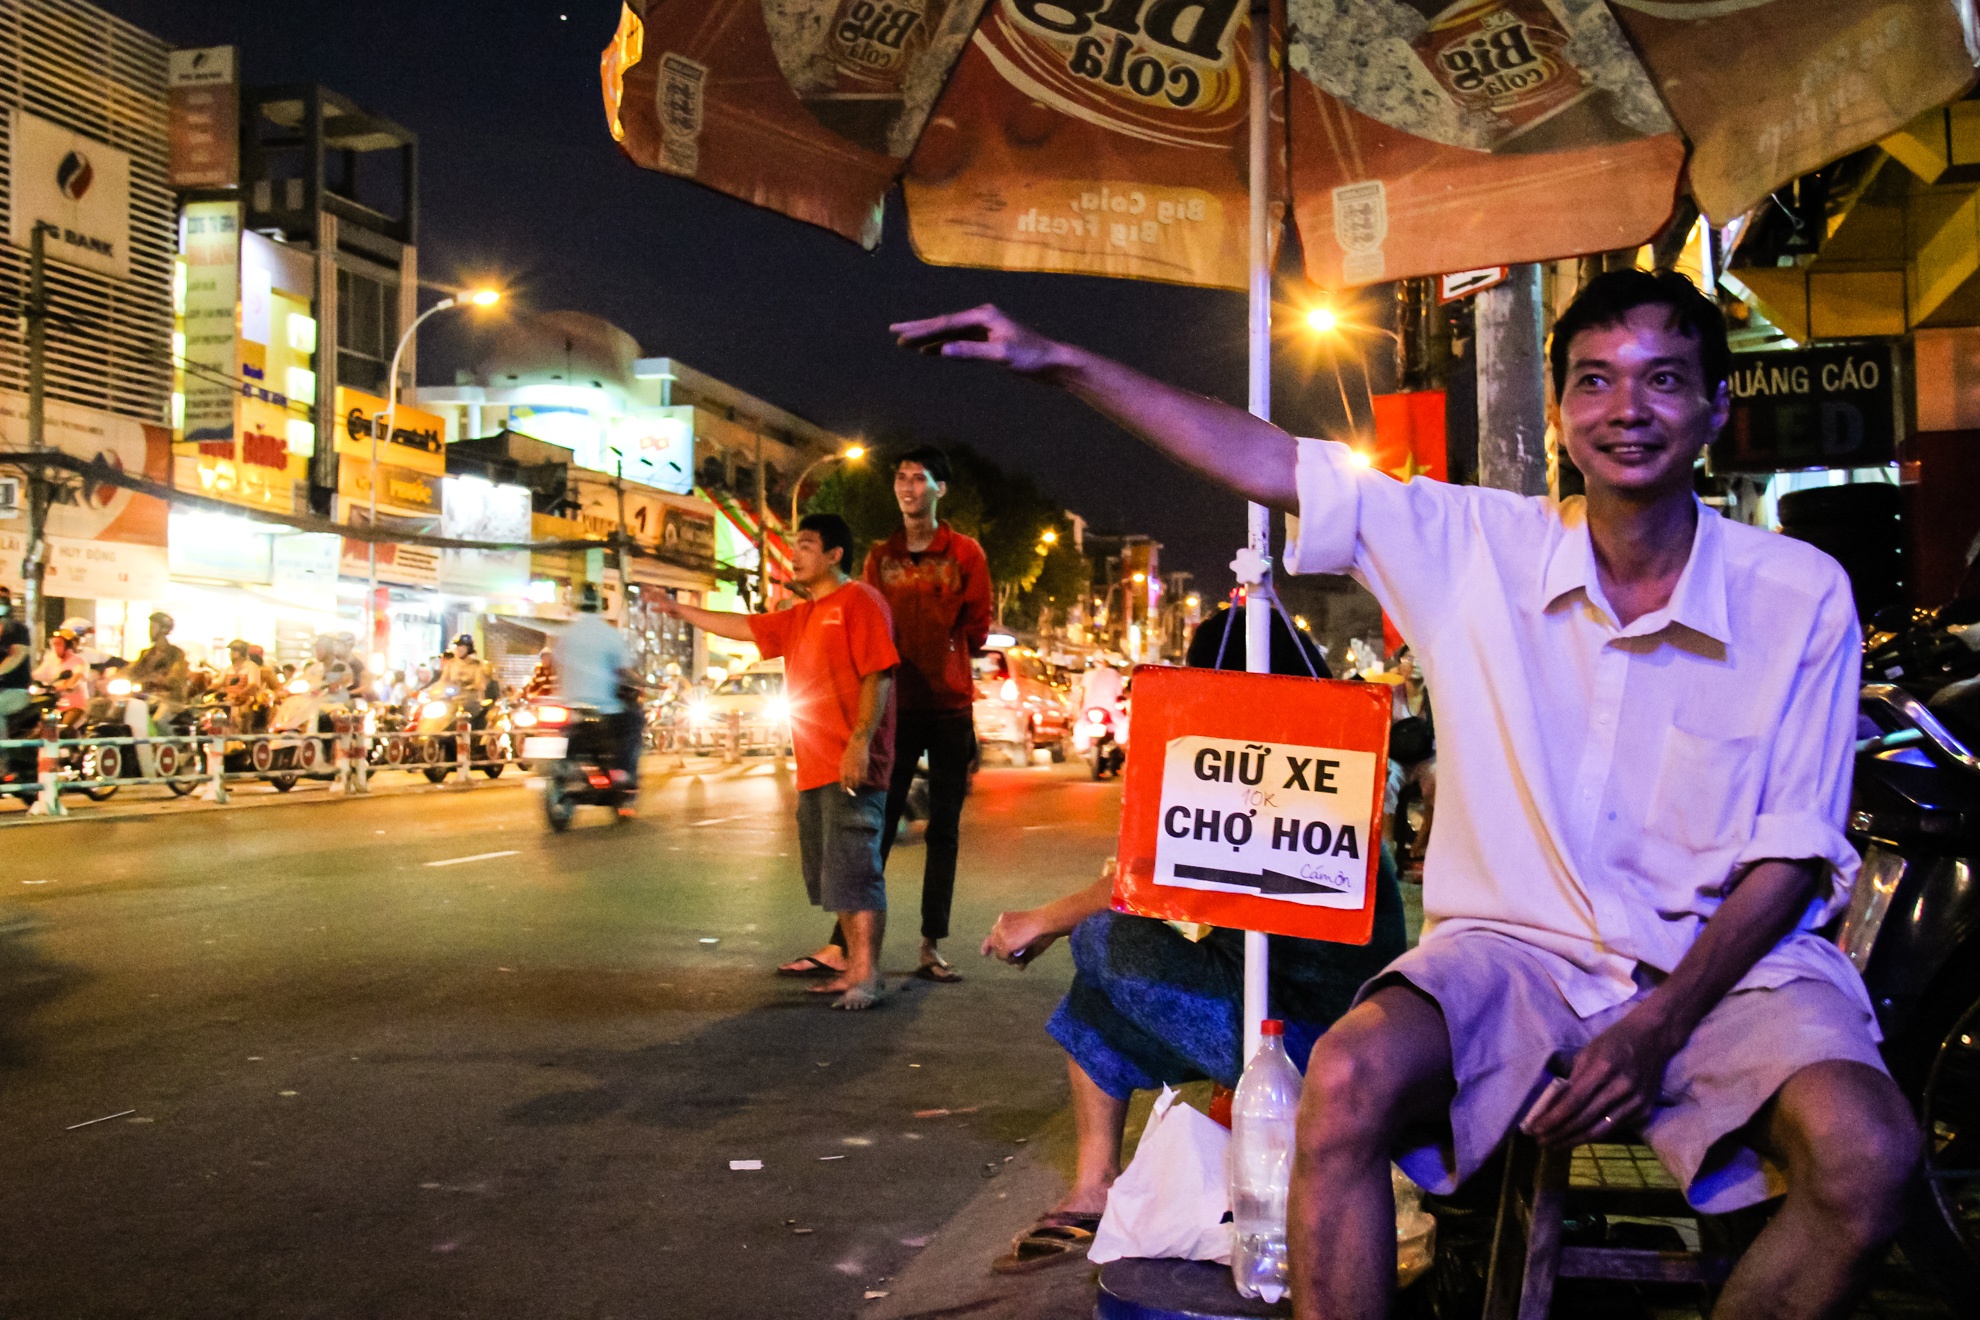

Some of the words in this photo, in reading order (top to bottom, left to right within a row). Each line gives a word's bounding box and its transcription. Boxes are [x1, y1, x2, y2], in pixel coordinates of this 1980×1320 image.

[64, 229, 114, 258] BANK
[1728, 361, 1810, 398] UẢNG
[1821, 357, 1880, 392] CÁO
[1193, 743, 1272, 786] GIỮ
[1282, 755, 1341, 795] XE
[1164, 804, 1258, 853] CHỢ
[1271, 816, 1361, 860] HOA
